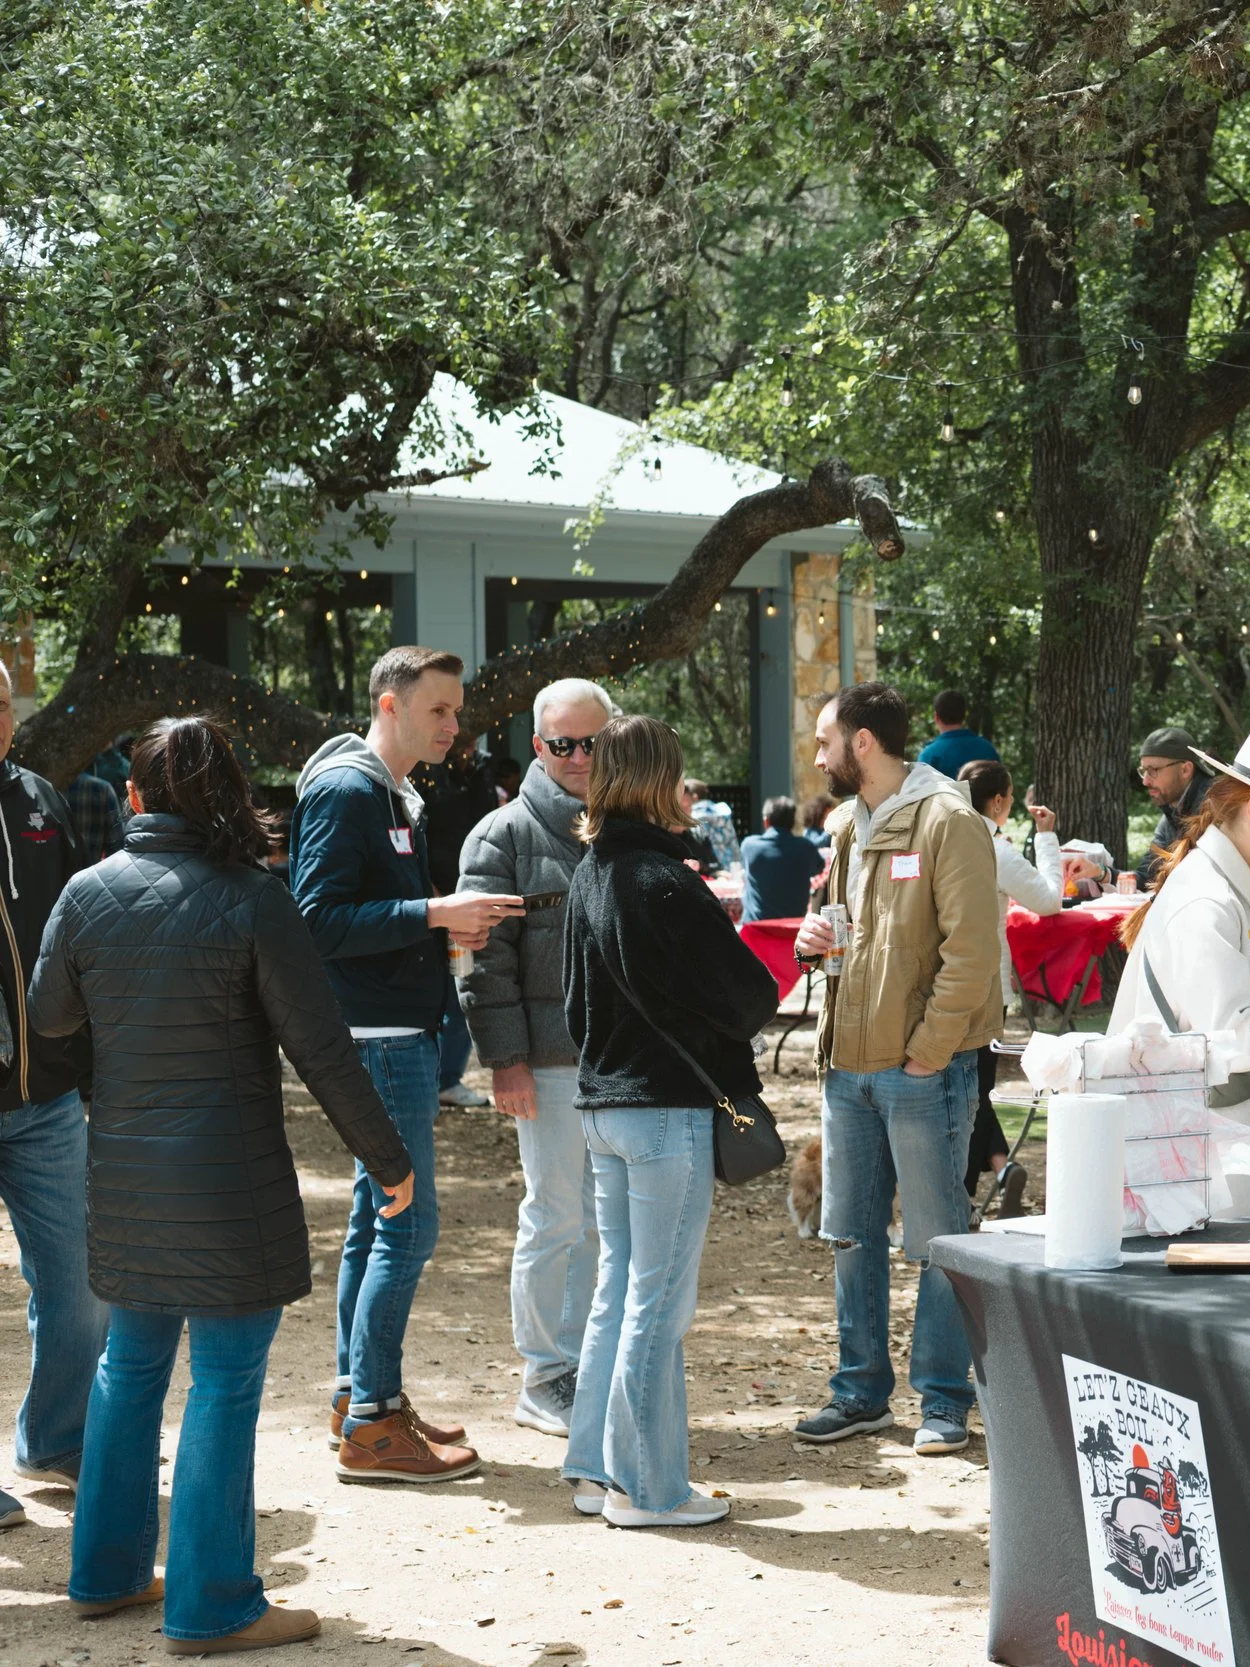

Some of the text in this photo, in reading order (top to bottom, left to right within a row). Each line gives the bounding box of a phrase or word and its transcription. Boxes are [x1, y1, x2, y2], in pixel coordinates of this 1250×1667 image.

[1073, 1373, 1191, 1441] LET'Z GEAUX
[1115, 1408, 1154, 1446] BOIL
[1056, 1610, 1154, 1667] Louisi
